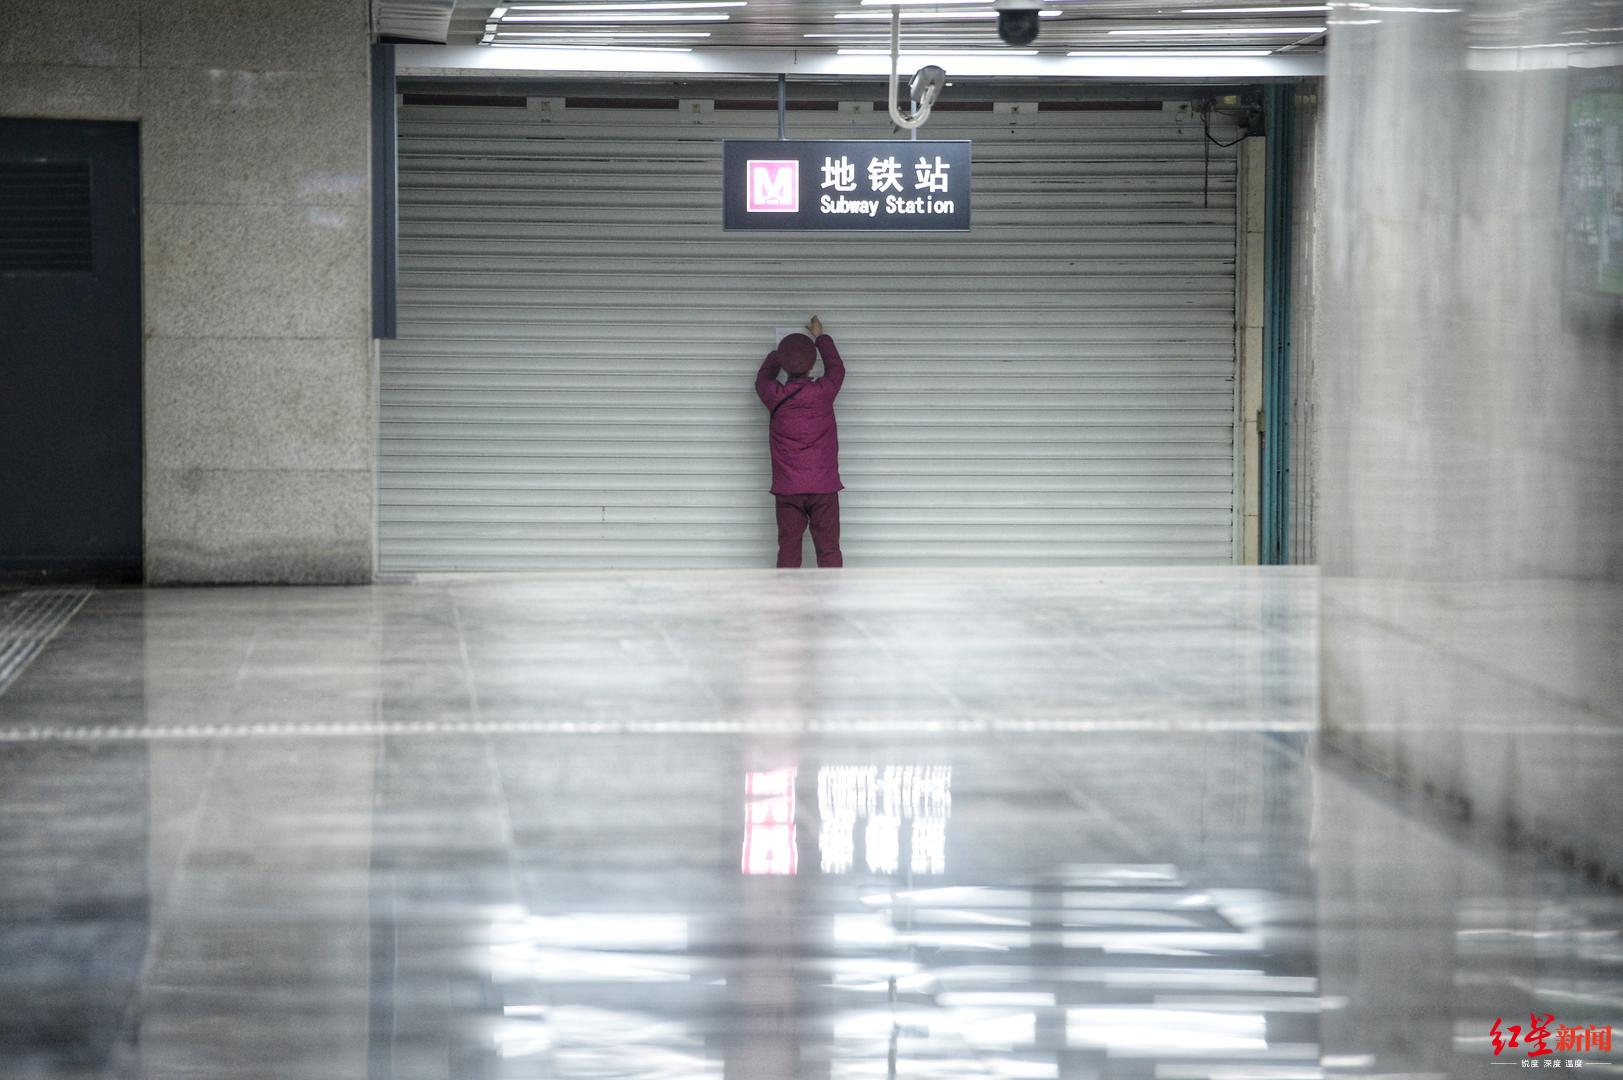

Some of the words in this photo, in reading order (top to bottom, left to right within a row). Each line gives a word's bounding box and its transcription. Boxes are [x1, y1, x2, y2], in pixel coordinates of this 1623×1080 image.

[821, 156, 950, 192] 地铁站
[821, 195, 879, 216] Subway
[886, 195, 954, 213] Station
